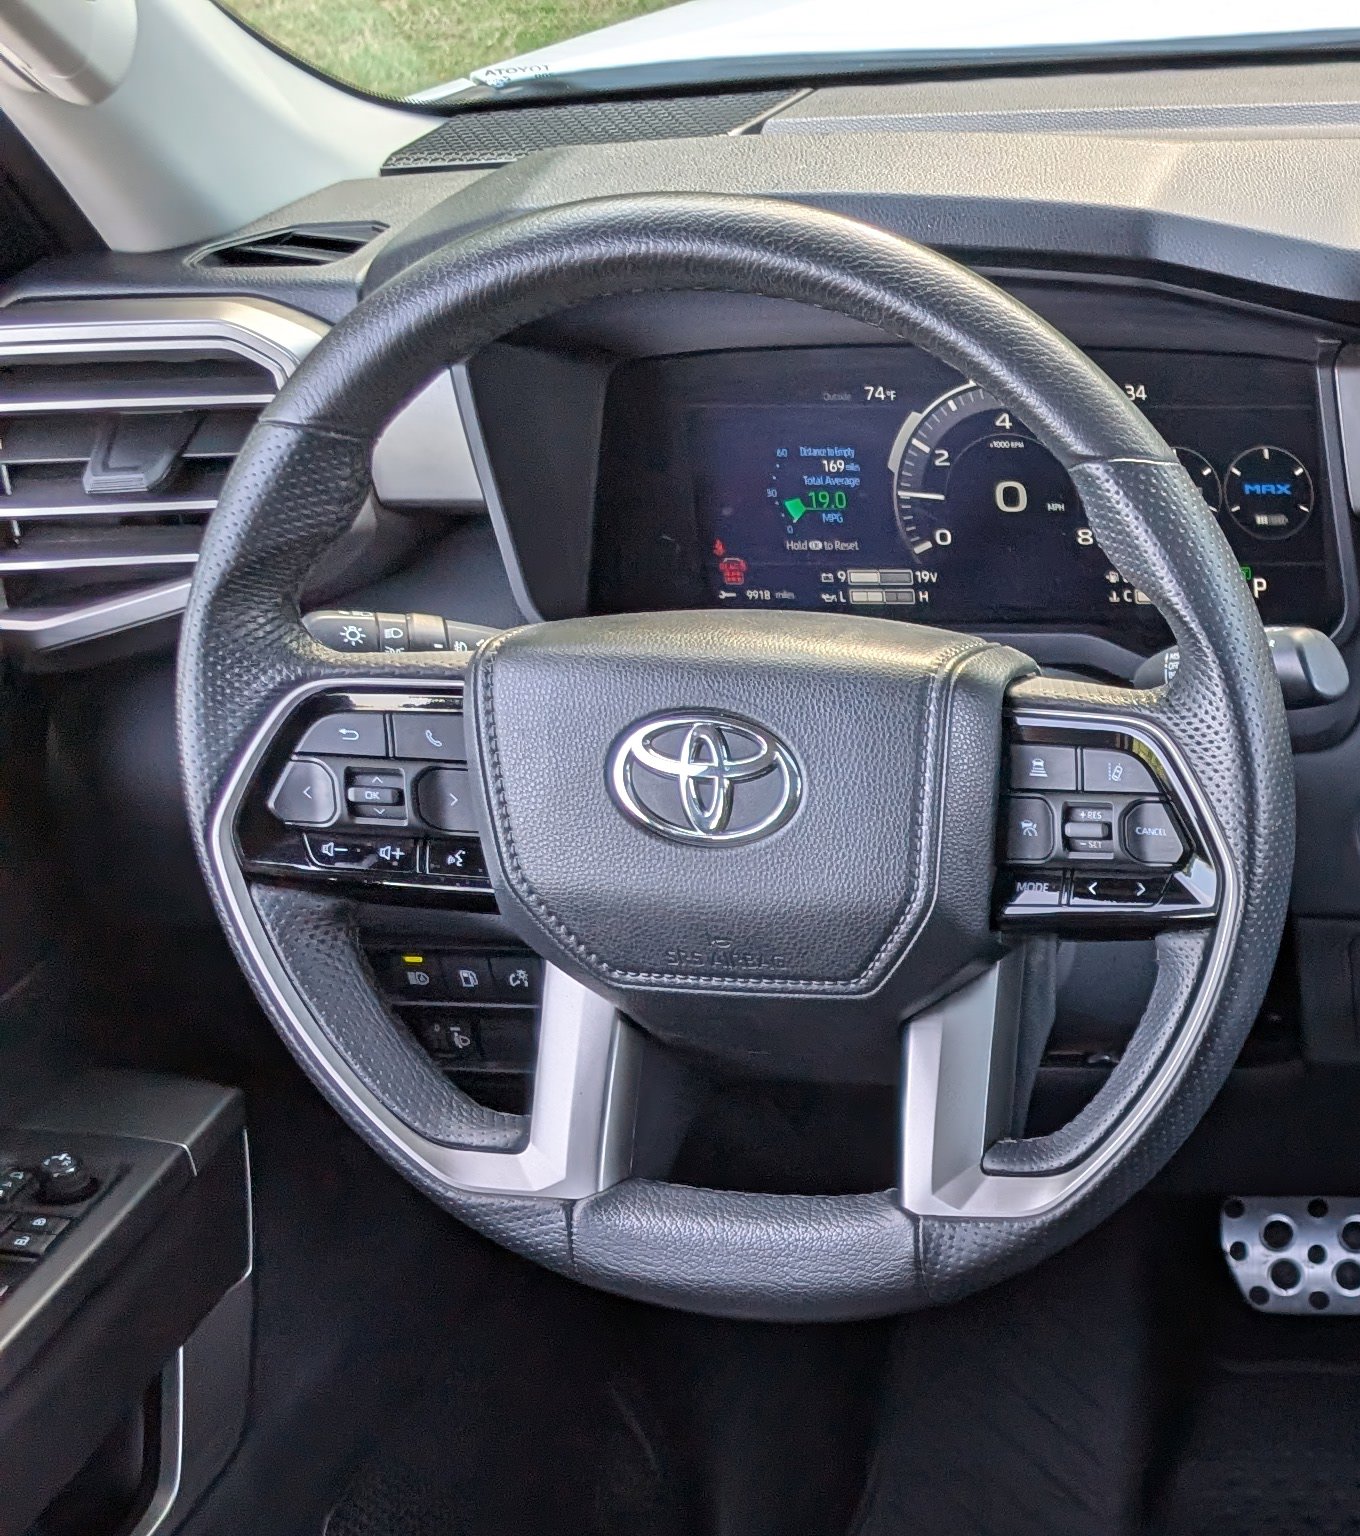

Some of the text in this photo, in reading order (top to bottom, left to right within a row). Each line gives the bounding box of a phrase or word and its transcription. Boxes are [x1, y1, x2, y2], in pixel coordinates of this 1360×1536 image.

[995, 413, 1012, 429] 4
[934, 449, 951, 466] 2
[822, 460, 845, 472] 169
[803, 475, 861, 488] Total Average
[1244, 483, 1292, 496] MAX
[808, 491, 847, 509] 19.0
[995, 480, 1028, 513] 0
[822, 513, 844, 523] MPG
[935, 529, 952, 545] 0
[1076, 528, 1094, 545] 8
[786, 540, 808, 551] Hold
[823, 541, 833, 550] to
[834, 540, 860, 551] Reset
[837, 569, 938, 582] 9 19V
[1253, 577, 1268, 598] P
[839, 591, 929, 603] L H
[365, 791, 380, 799] OK
[1135, 827, 1167, 836] CANCEL
[1016, 881, 1049, 892] MODE
